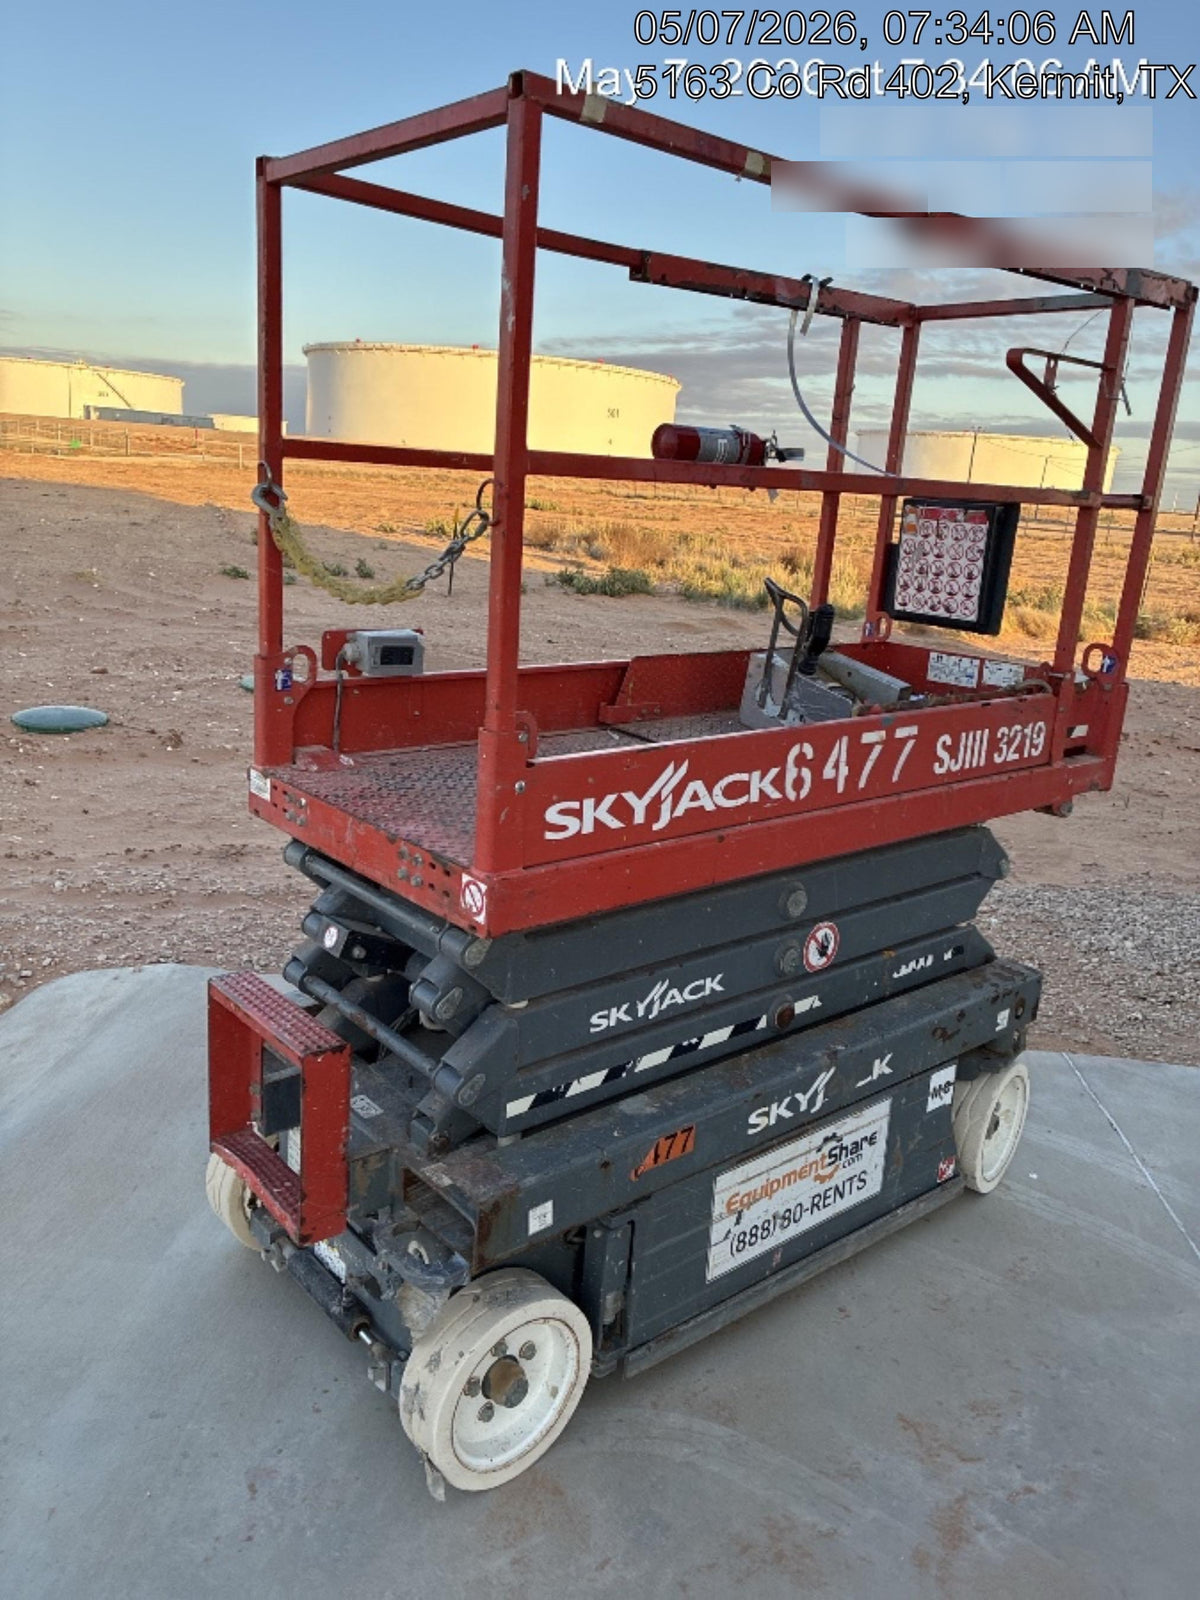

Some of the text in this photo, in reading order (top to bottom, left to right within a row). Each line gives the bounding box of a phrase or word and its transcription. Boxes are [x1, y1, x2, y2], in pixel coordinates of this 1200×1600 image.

[785, 725, 918, 801] 6477
[994, 721, 1046, 763] 3219
[544, 759, 783, 839] SKYJACK
[590, 973, 725, 1033] SKYJACK
[747, 1052, 893, 1135] SKYJK
[725, 1131, 878, 1214] EquipmentShare
